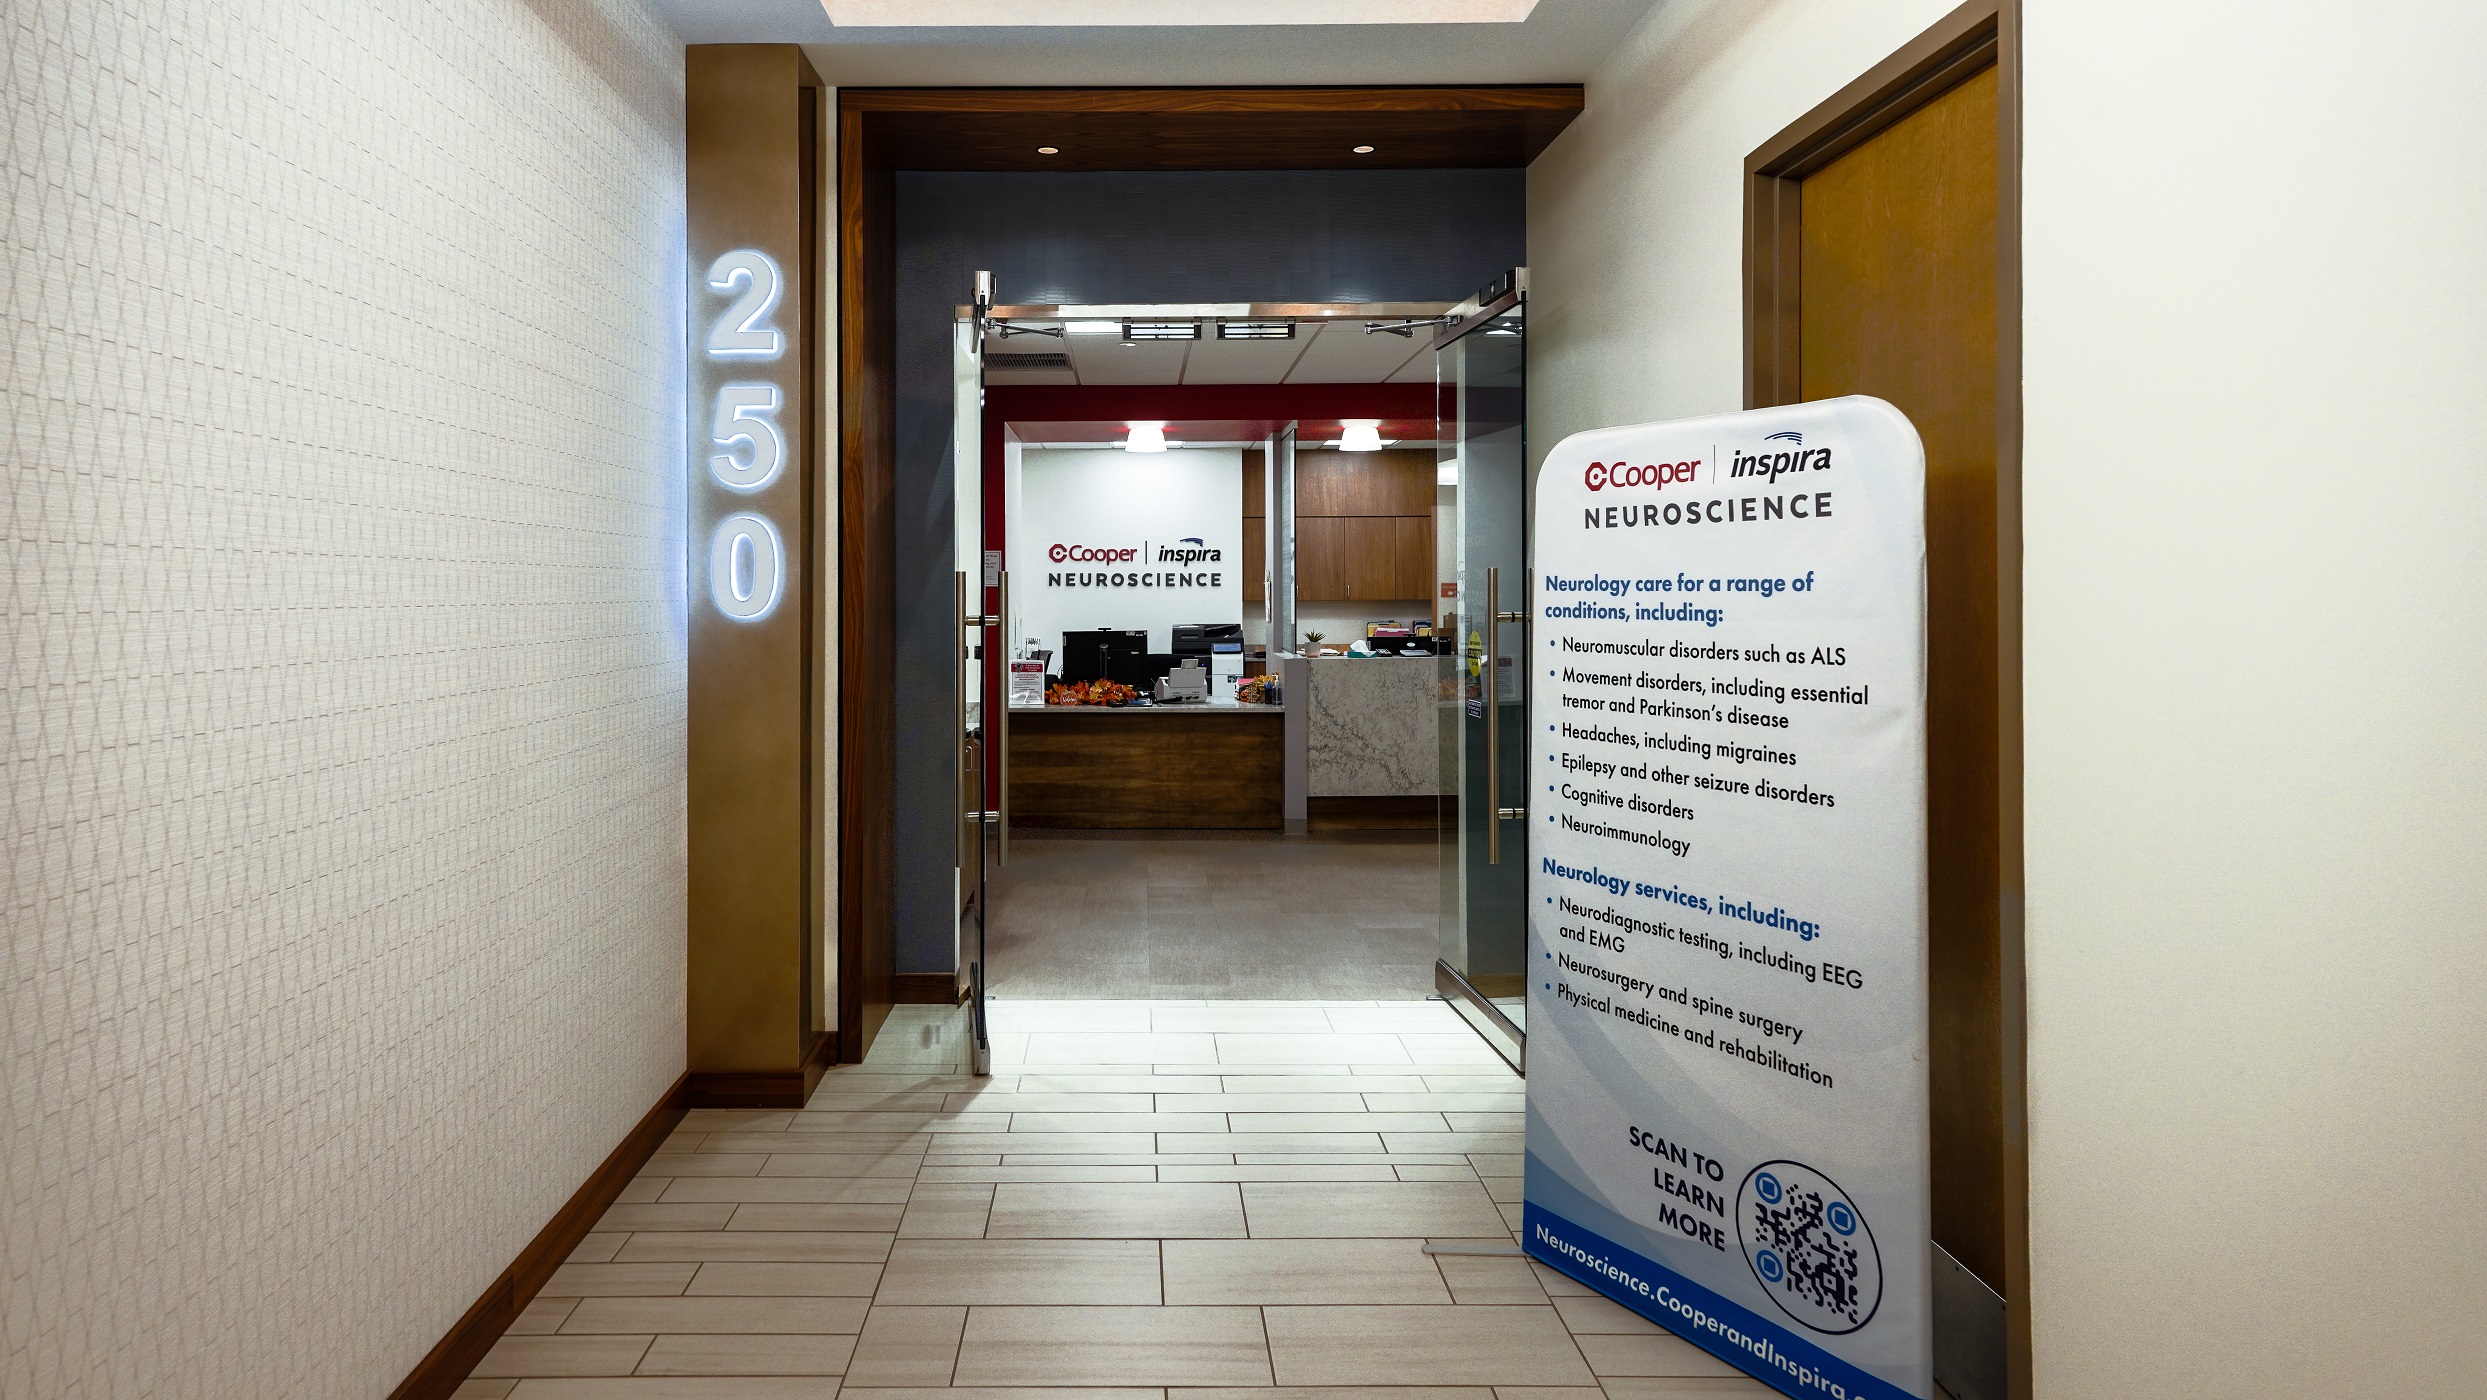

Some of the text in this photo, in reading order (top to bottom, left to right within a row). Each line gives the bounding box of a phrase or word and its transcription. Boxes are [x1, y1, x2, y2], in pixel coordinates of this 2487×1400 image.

[707, 251, 779, 618] 250
[1609, 448, 1832, 490] Cooper inspira
[1585, 492, 1832, 529] NEUROSCIENCE
[1068, 545, 1221, 567] Cooper inspira
[1048, 572, 1222, 588] NEUROSCIENCE
[1546, 570, 1814, 598] Neurology care for a range of
[1545, 601, 1724, 628] conditions, including:
[1562, 636, 1846, 666] Neuromuscular disorders such as ALS
[1562, 666, 1868, 705] Movement disorders, including essential
[1562, 693, 1606, 711] tremor
[1609, 696, 1635, 714] and
[1727, 705, 1789, 729] disease
[1562, 722, 1797, 766] Headaches, including migraines
[1562, 752, 1835, 808] Epilepsy and other seizure disorders
[1561, 783, 1694, 821] Cognitive disorders
[1561, 812, 1691, 858] Neuroimmunology
[1543, 857, 1820, 942] Neurology services, including:
[1559, 925, 1625, 953] and EMG
[1560, 895, 1863, 989] Neurodiagnostic testing, including EEG
[1559, 951, 1803, 1045] Neurosurgery and spine surgery
[1558, 982, 1833, 1089] Physical medicine and rehabilitation
[1629, 1126, 1724, 1182] SCAN TO
[1654, 1167, 1724, 1218] LEARN
[1659, 1203, 1725, 1252] MORE
